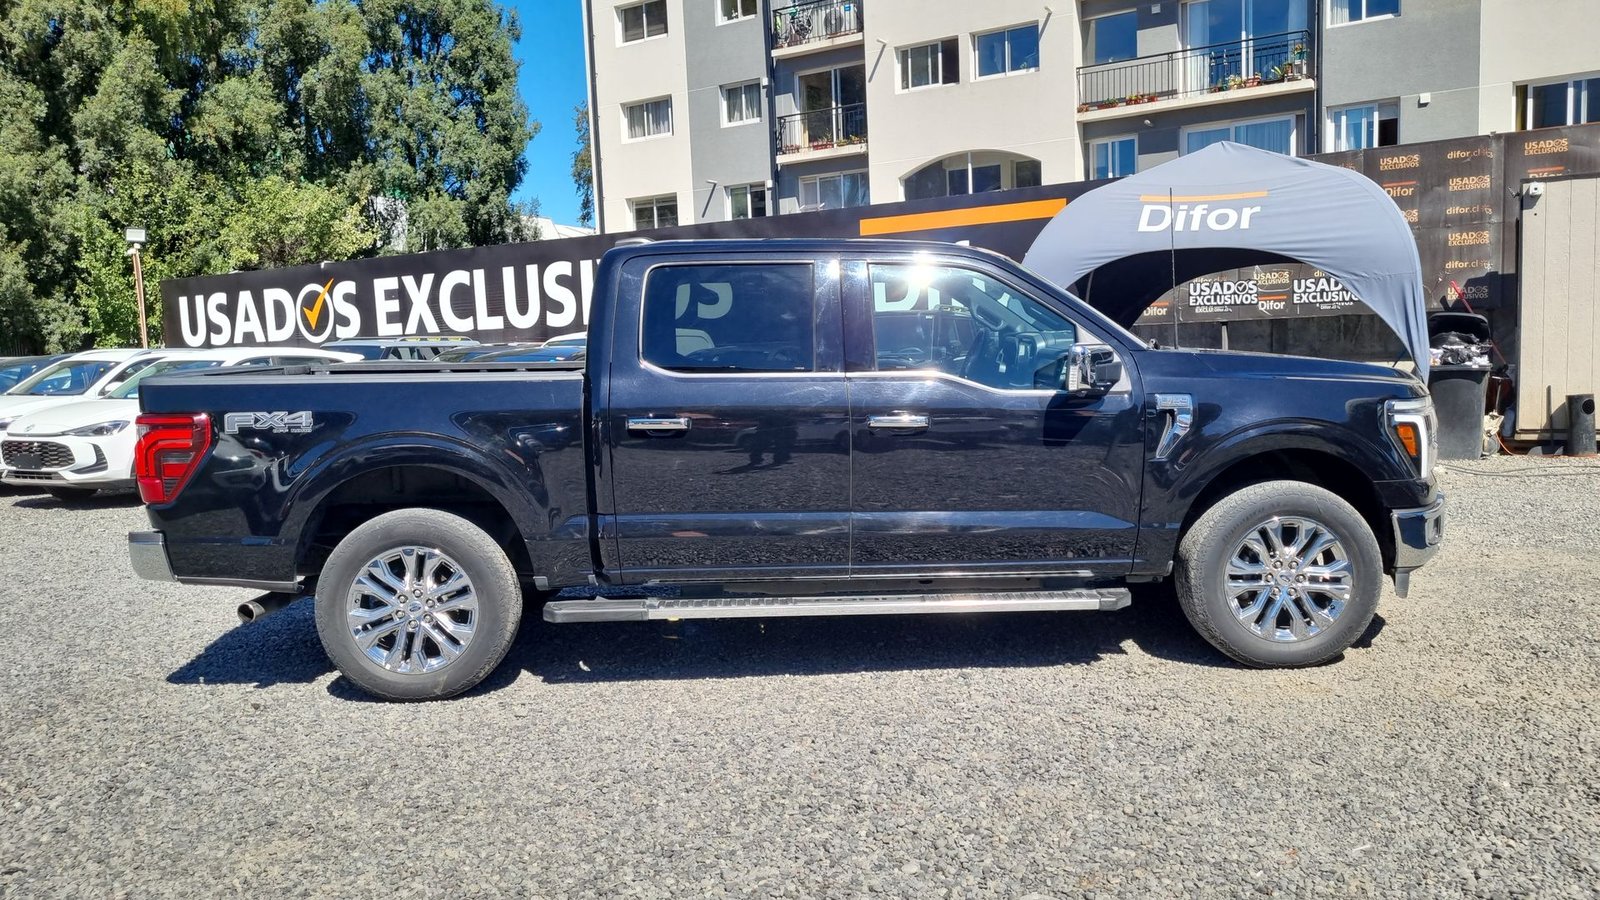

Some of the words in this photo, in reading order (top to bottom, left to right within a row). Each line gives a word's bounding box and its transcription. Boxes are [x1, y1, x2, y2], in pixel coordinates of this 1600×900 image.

[1525, 139, 1568, 150] USADOS
[1524, 146, 1568, 155] EXCLUSIVOS
[1380, 155, 1419, 165] USADOS
[1380, 161, 1419, 171] EXCLUSIVOS
[1449, 175, 1490, 186] USADOS
[1449, 182, 1490, 192] EXCLUSIVOS
[1446, 205, 1479, 215] difor.cl
[1138, 204, 1261, 232] Difor
[1448, 231, 1489, 241] USADOS
[1448, 239, 1489, 247] EXCLUSIVOS
[1445, 260, 1478, 269] difor.cl
[1254, 272, 1289, 280] USADOS
[1257, 278, 1290, 286] XCLUSIVOS
[1293, 277, 1343, 293] USAD
[1189, 280, 1258, 296] USADOS
[1447, 286, 1488, 295] UADOS
[1189, 293, 1258, 306] EXCLUSIVOS
[1259, 300, 1285, 310] Difor
[178, 278, 361, 348] USADOS
[223, 411, 313, 434] FX4
